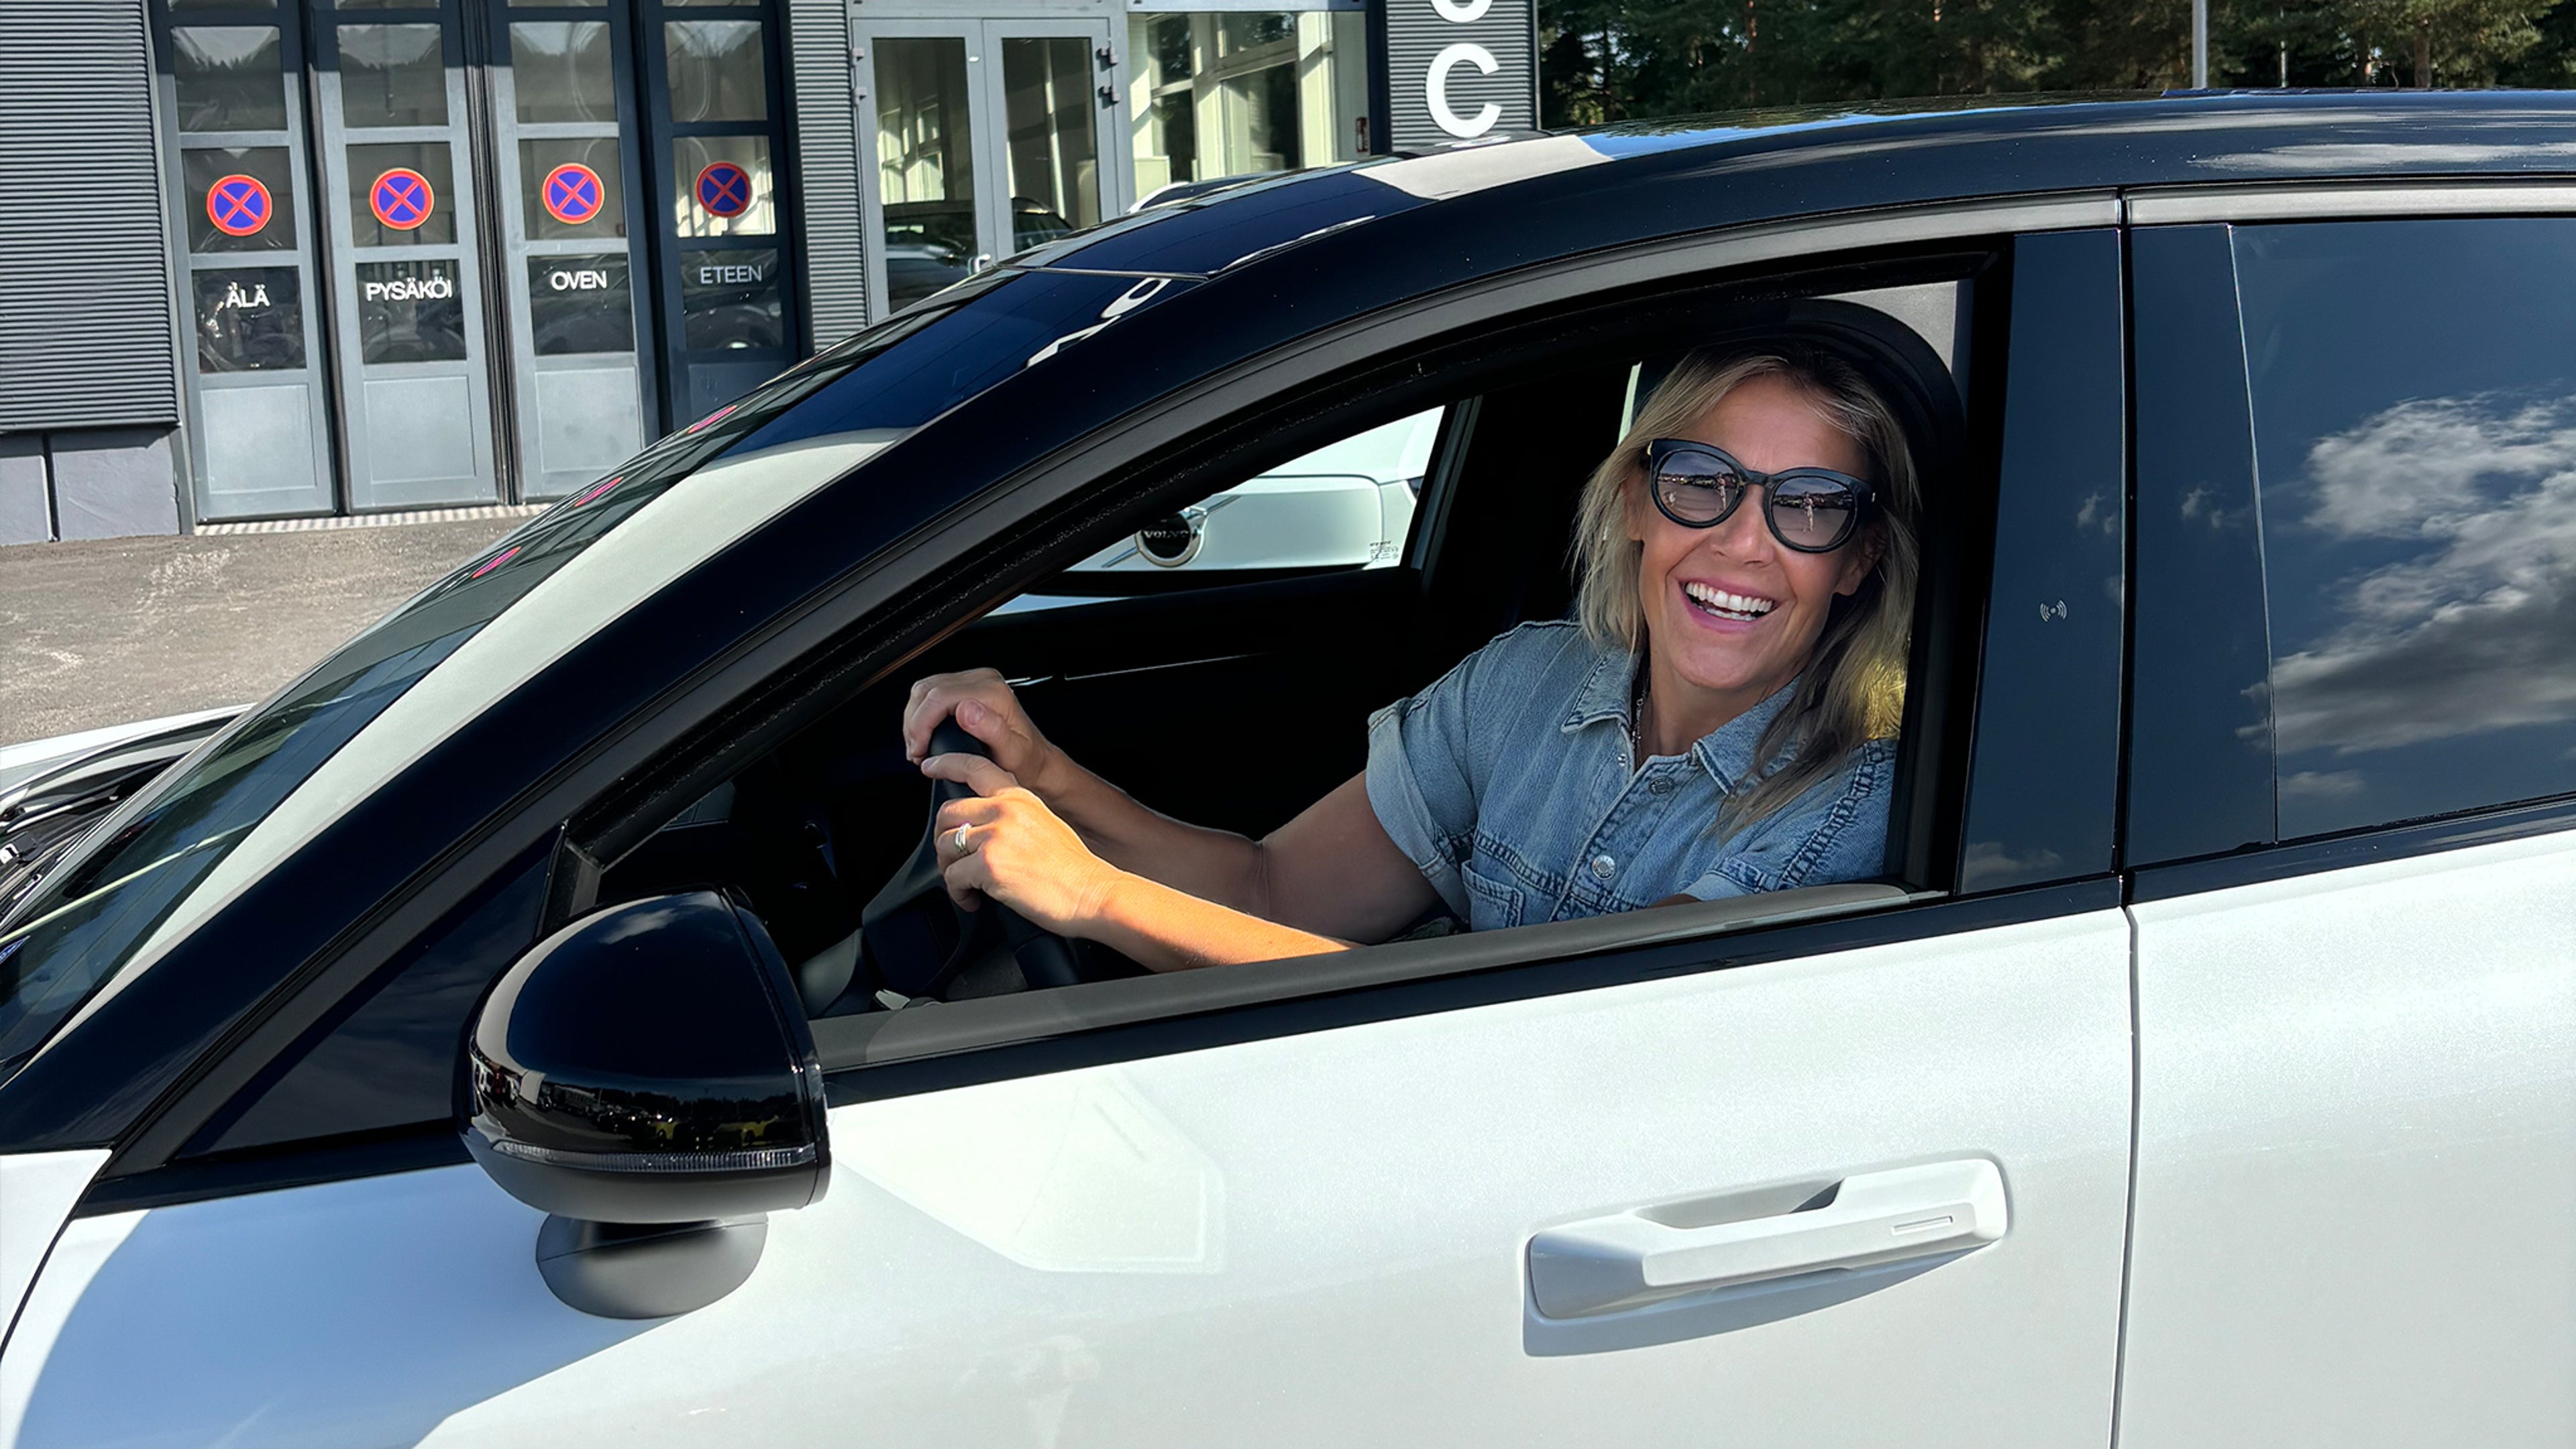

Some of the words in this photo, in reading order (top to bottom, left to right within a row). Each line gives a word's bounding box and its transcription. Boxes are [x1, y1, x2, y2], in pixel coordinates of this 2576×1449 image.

[1426, 0, 1502, 138] C
[226, 282, 270, 308] ÄLÄ
[366, 276, 453, 301] PYSÄKÖI
[551, 270, 607, 290] OVEN
[700, 266, 762, 284] ETEEN
[1142, 530, 1189, 539] VOLVO
